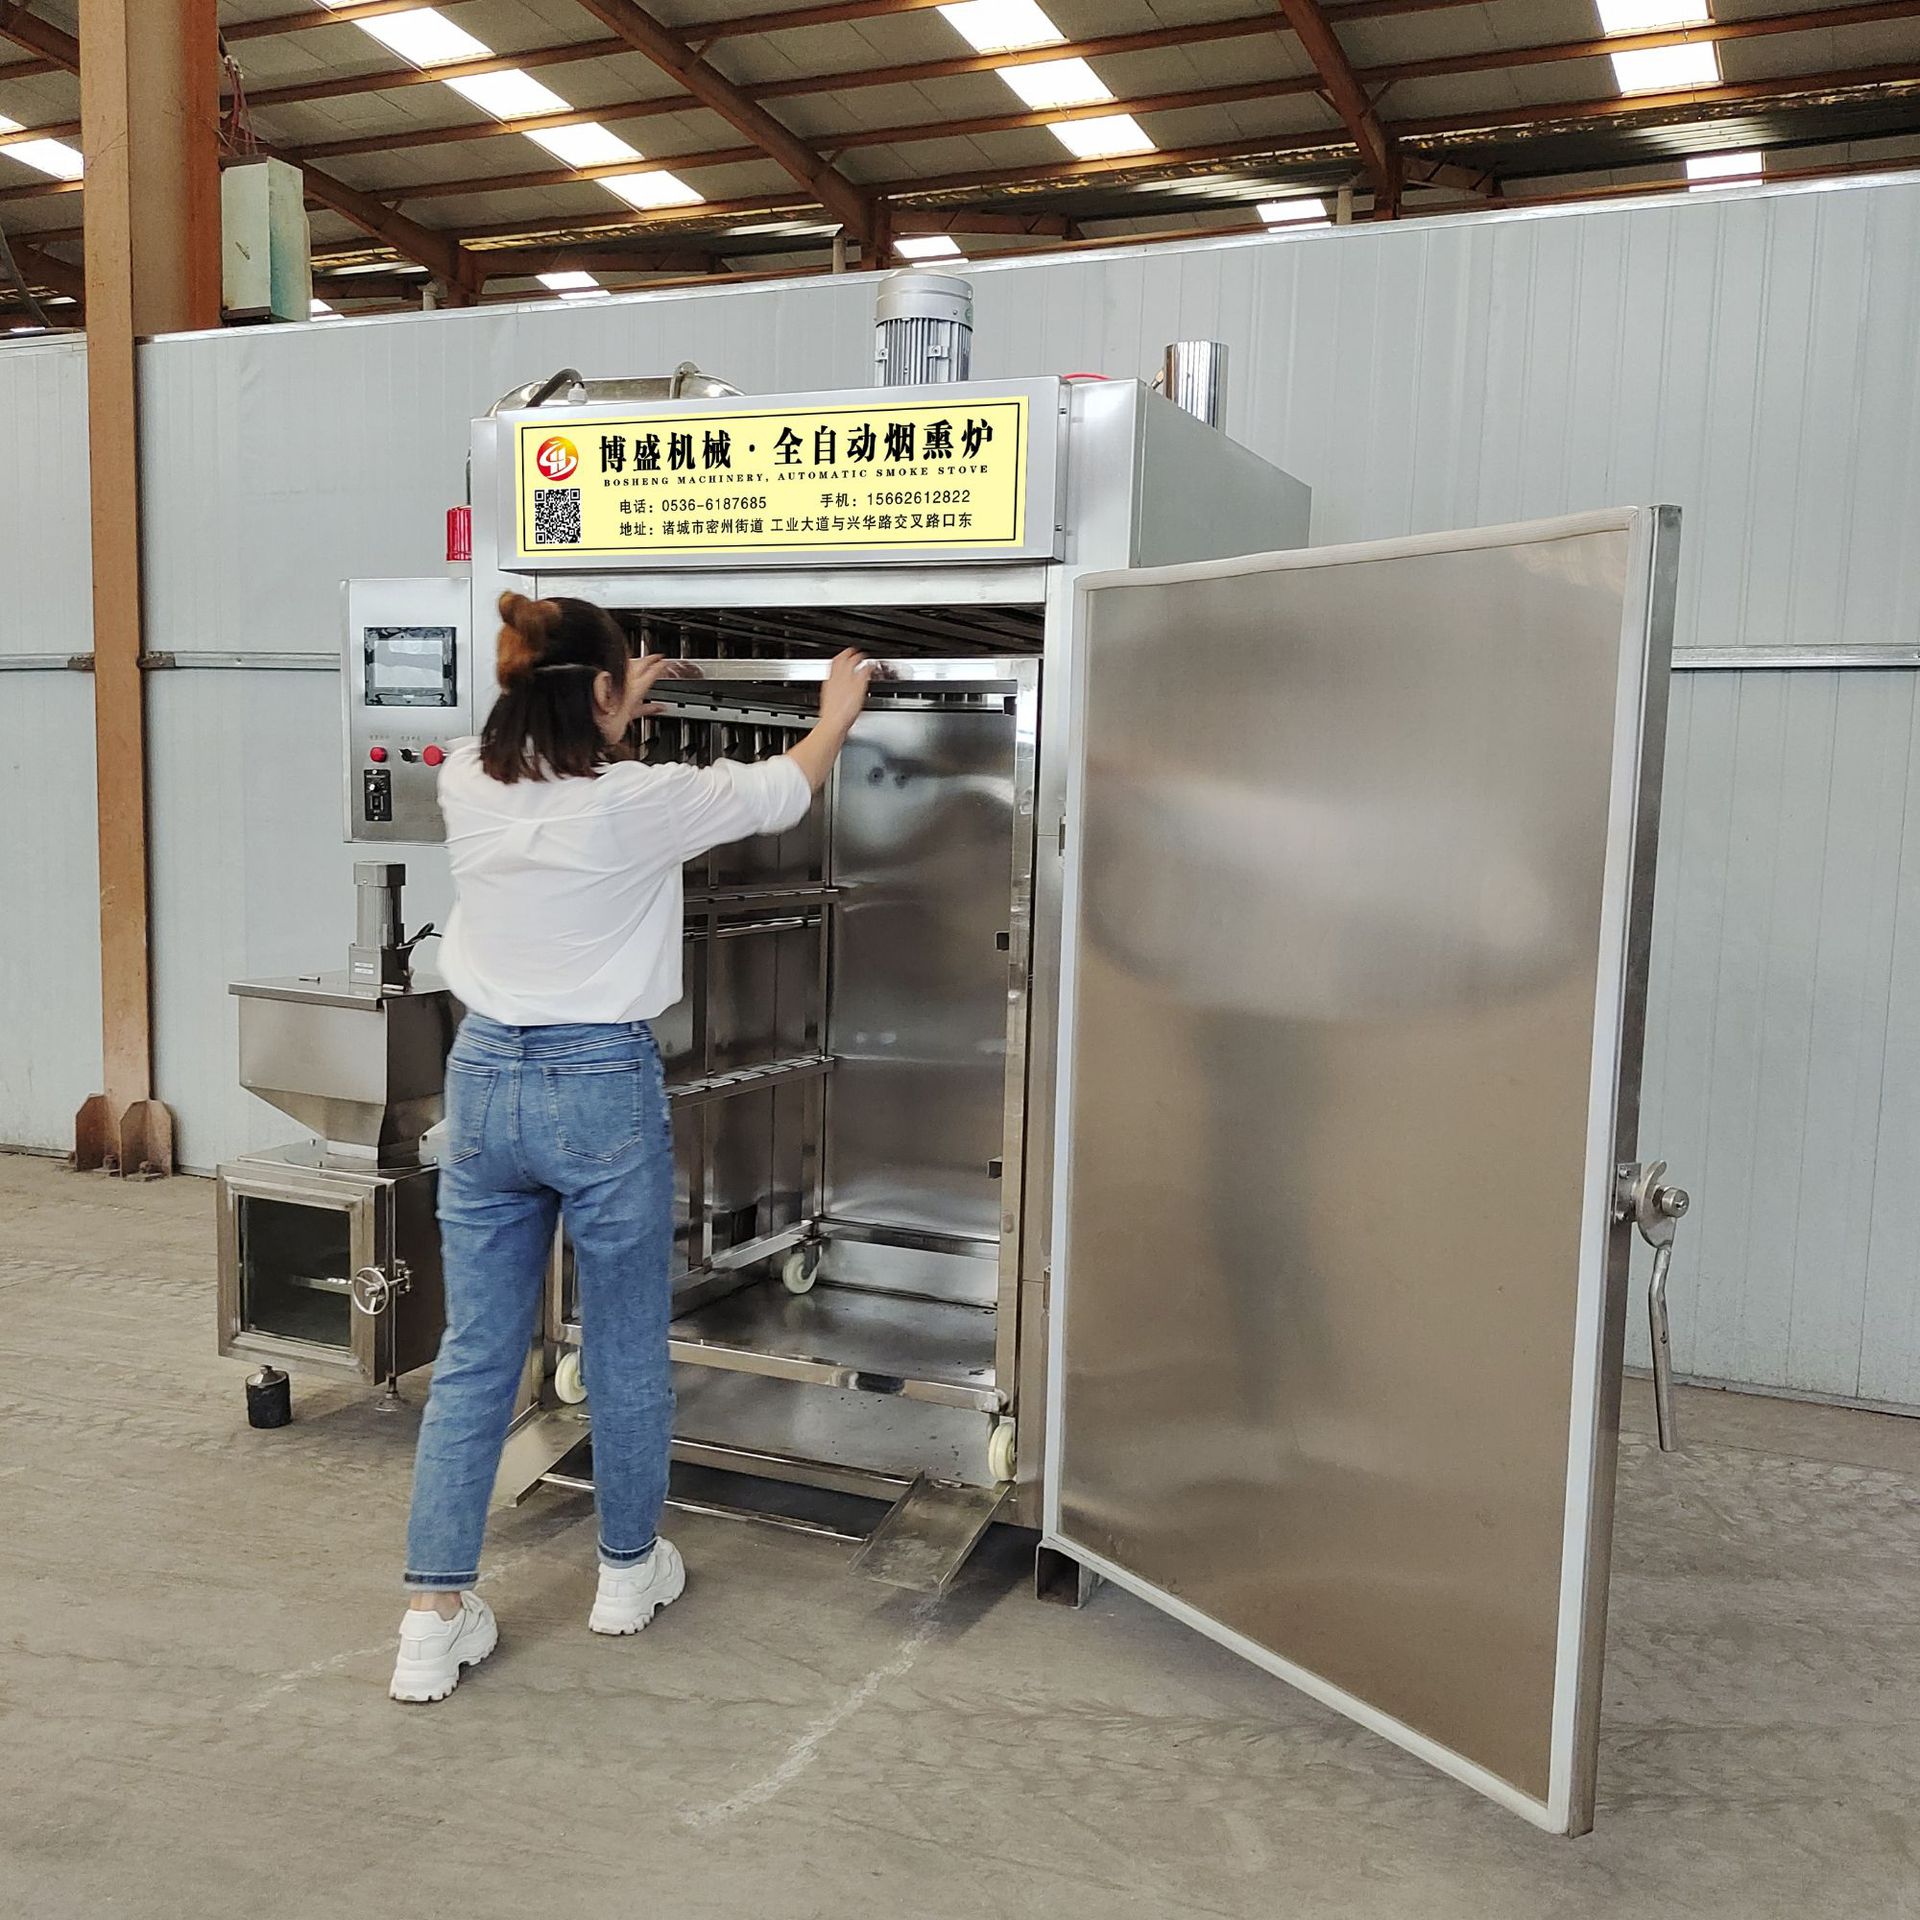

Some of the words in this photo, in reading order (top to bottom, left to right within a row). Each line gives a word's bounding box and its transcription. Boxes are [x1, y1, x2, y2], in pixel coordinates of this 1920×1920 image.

[603, 477, 669, 488] BOSHENG
[677, 473, 769, 485] MACHINERY,
[777, 469, 868, 481] AUTOMATIC
[875, 466, 929, 477] SMOKE
[937, 464, 989, 475] STOVE
